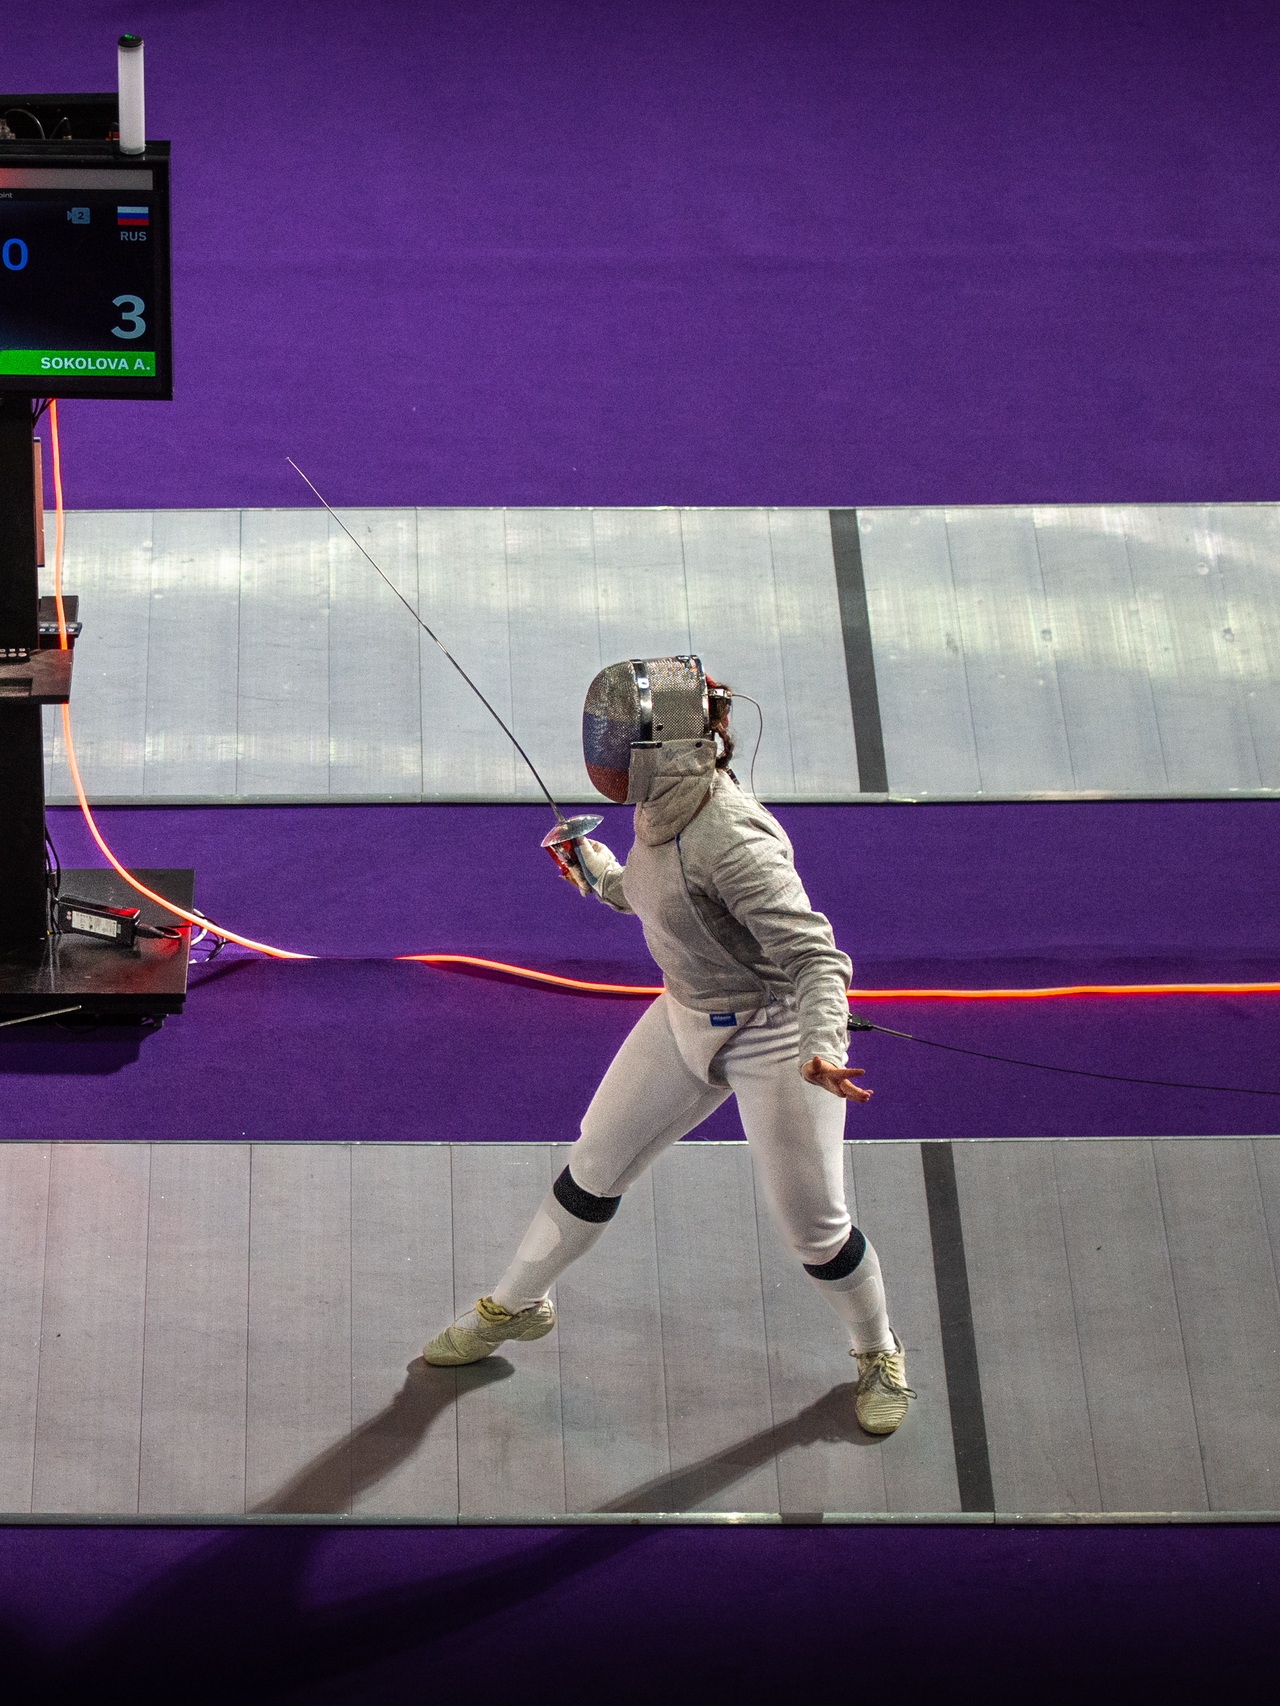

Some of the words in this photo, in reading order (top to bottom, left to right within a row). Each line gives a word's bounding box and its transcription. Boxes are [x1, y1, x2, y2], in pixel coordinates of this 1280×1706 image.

[77, 211, 85, 220] 2
[120, 231, 147, 241] RUS
[110, 294, 147, 339] 3
[40, 356, 129, 370] SOKOLOVA
[133, 358, 151, 371] A.
